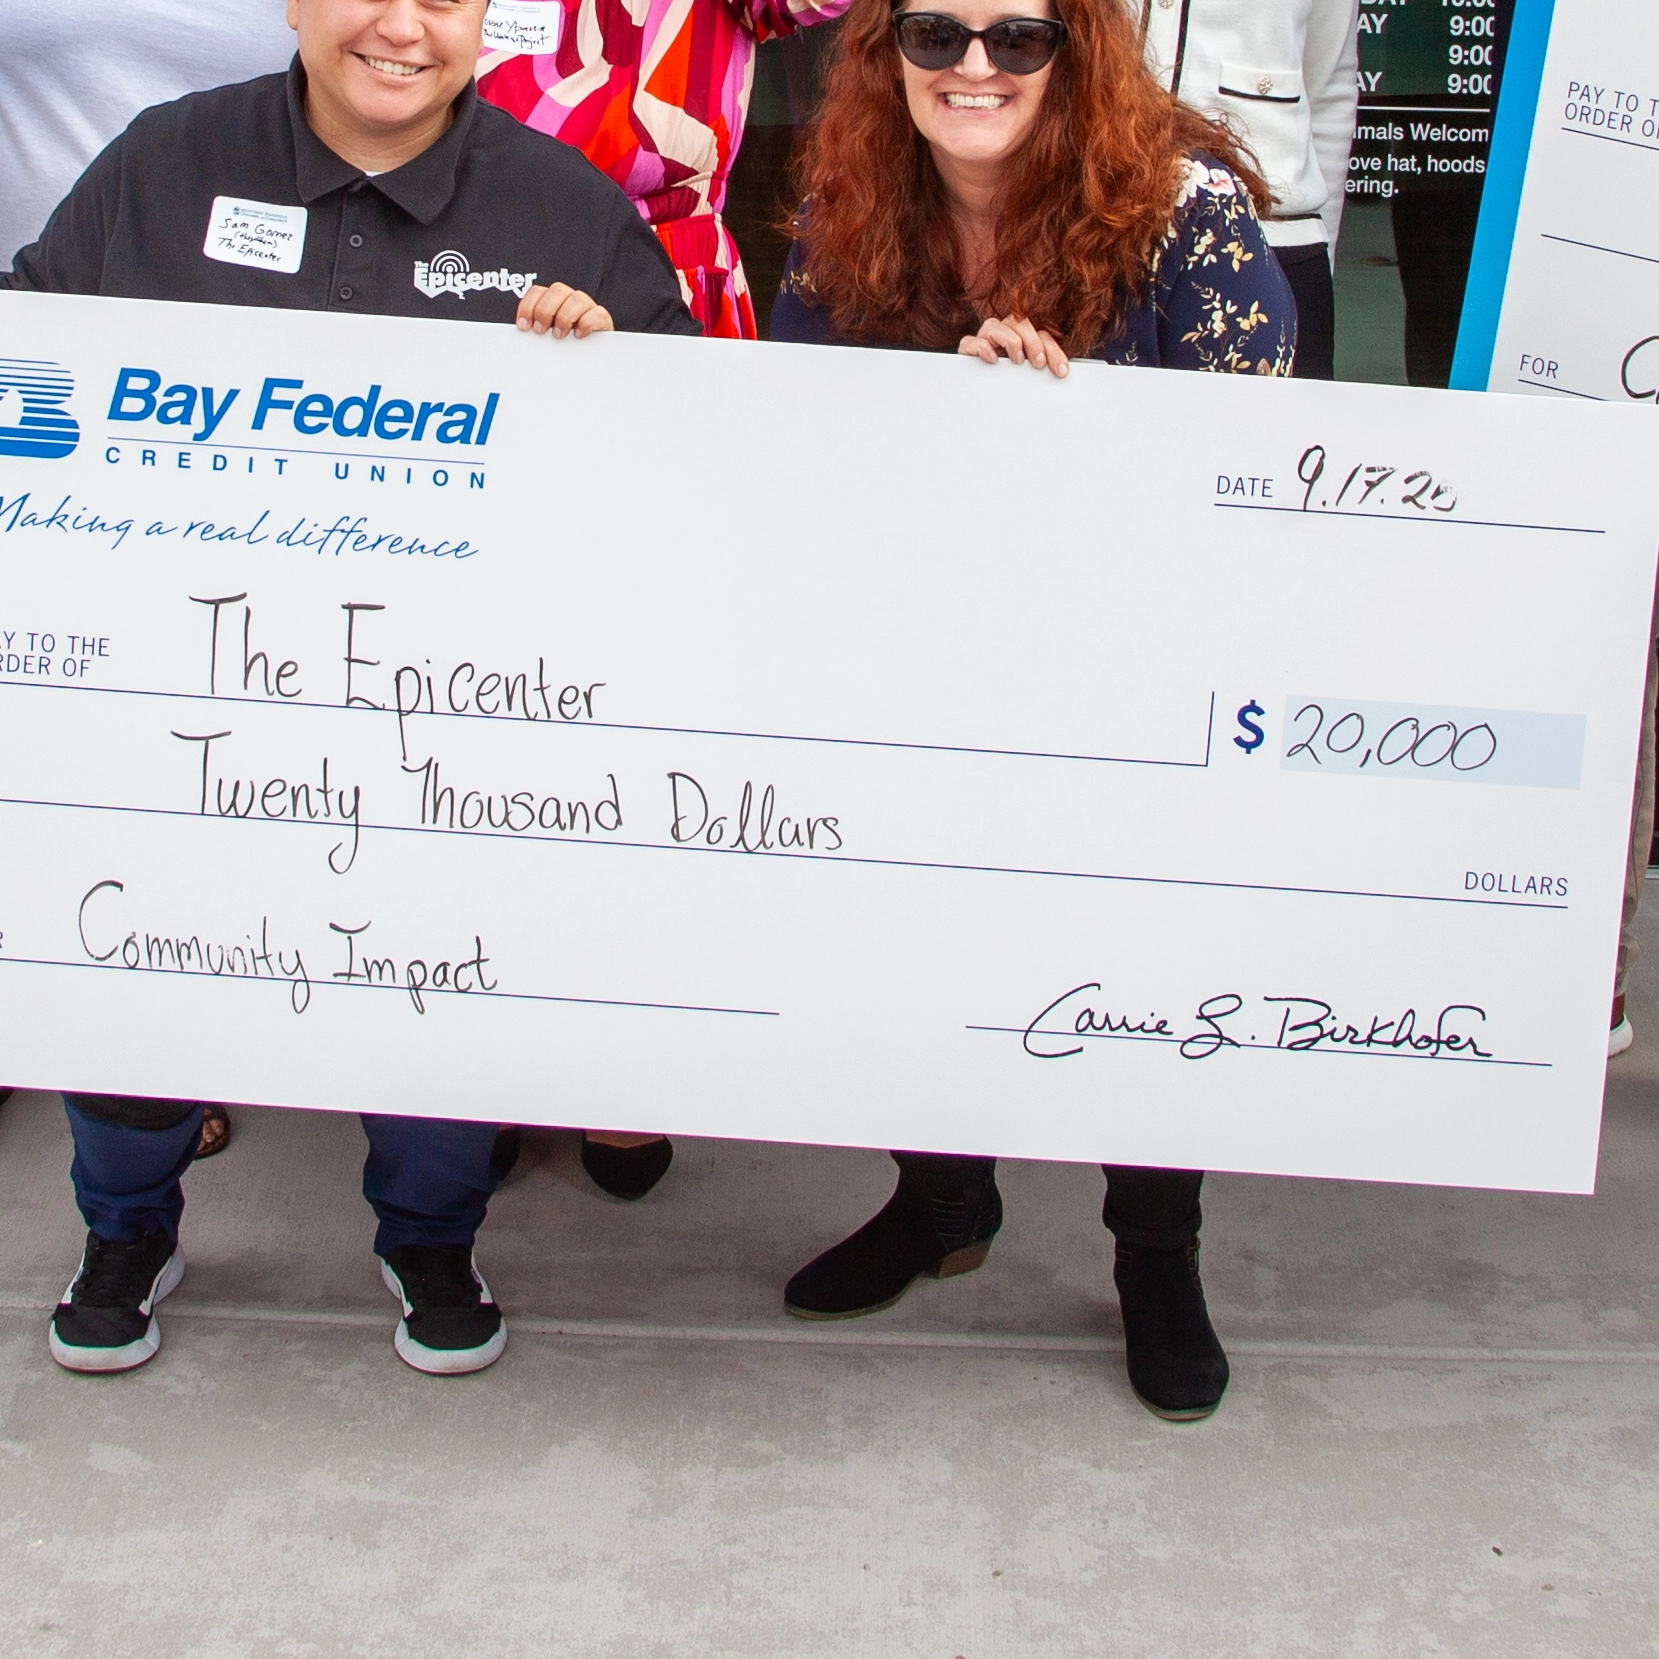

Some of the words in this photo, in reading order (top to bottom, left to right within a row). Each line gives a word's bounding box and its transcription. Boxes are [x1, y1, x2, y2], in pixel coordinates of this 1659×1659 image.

[1568, 82, 1604, 104] PAY
[1614, 90, 1641, 113] TO
[1410, 123, 1488, 142] Welcom
[1564, 103, 1633, 133] ORDER
[1388, 154, 1421, 175] hat,
[1345, 173, 1398, 196] ering.
[219, 218, 249, 229] Sam
[414, 267, 538, 298] Epicenter
[1520, 354, 1558, 378] FOR
[107, 367, 240, 440] Bay
[252, 376, 501, 446] Federal
[106, 447, 288, 476] CREDIT
[335, 463, 485, 490] UNION
[1216, 475, 1274, 498] DATE
[146, 520, 178, 537] a
[183, 510, 271, 545] real
[276, 515, 479, 560] difference
[27, 632, 55, 653] TO
[67, 635, 110, 657] THE
[62, 657, 90, 678] OF
[189, 592, 302, 698] The
[342, 603, 607, 761] Epicenter
[1287, 704, 1497, 770] 20,000
[170, 731, 362, 874] Twenty
[401, 759, 624, 833] Thousand
[668, 772, 844, 853] Dollars
[1465, 871, 1568, 897] DOLLARS
[79, 880, 310, 1014] Community
[329, 921, 498, 1014] Impact
